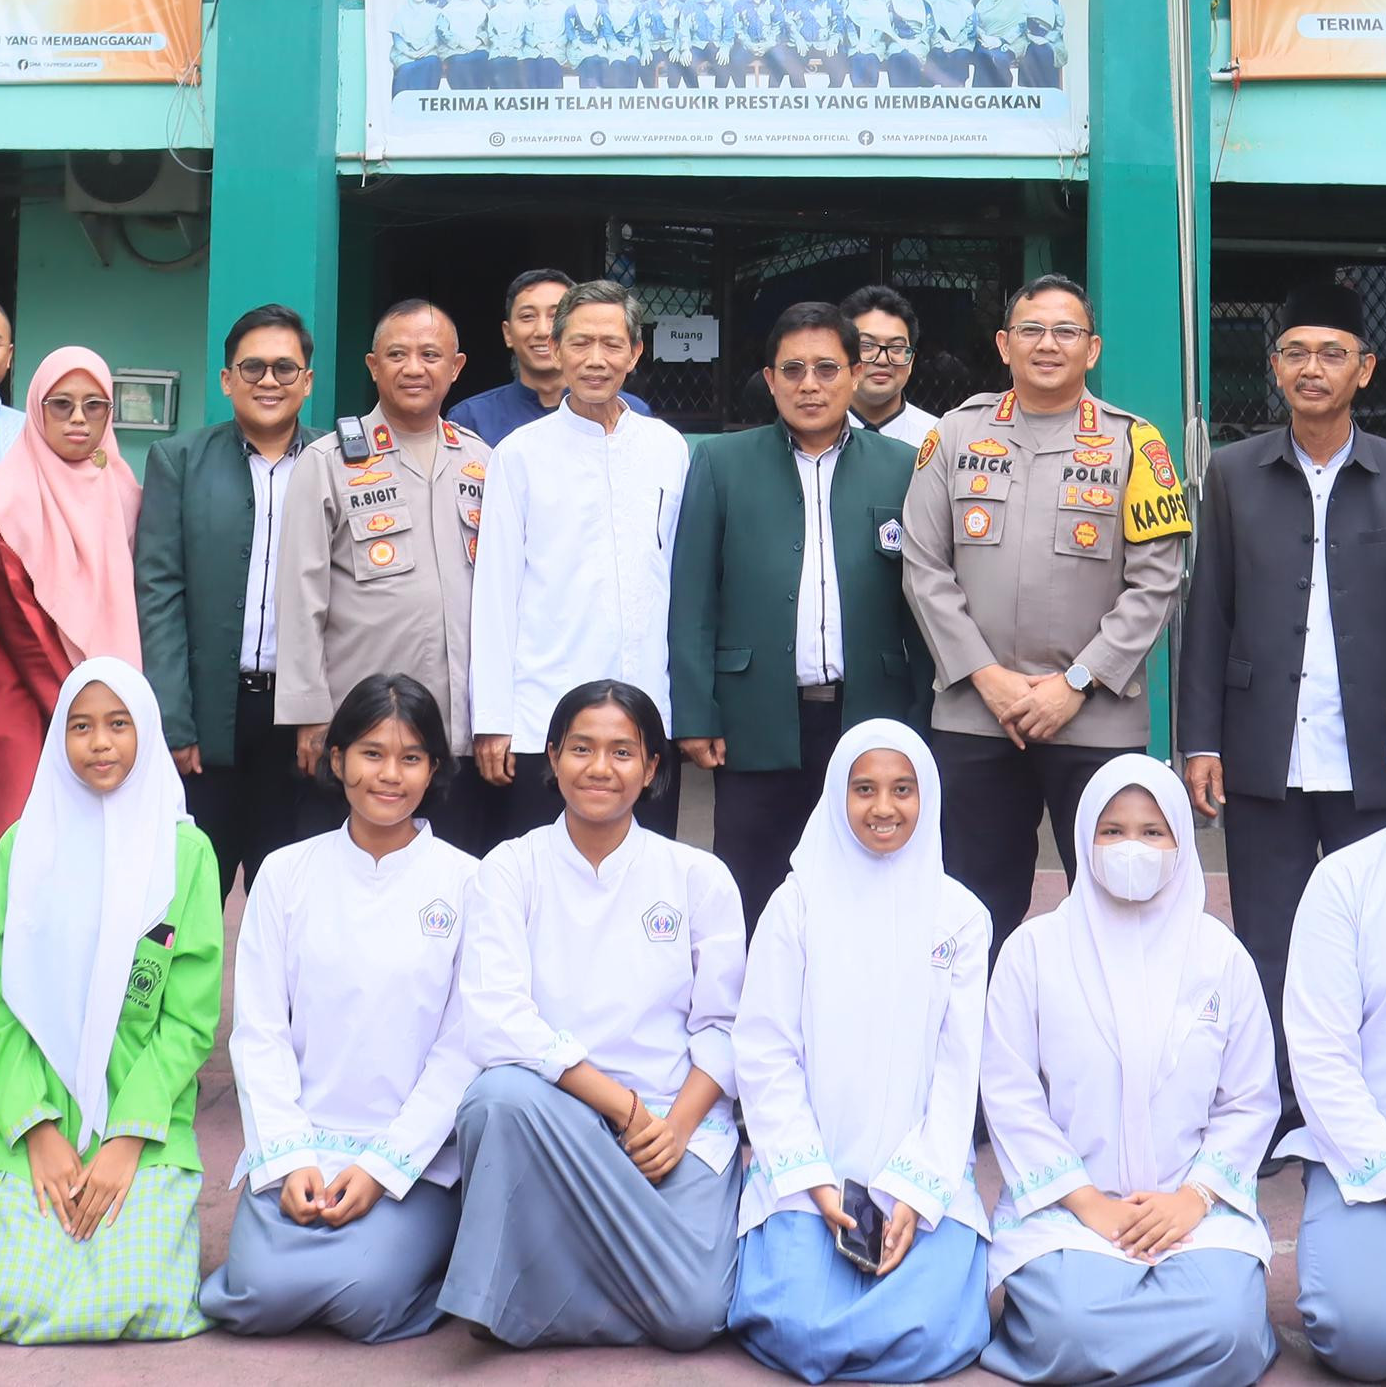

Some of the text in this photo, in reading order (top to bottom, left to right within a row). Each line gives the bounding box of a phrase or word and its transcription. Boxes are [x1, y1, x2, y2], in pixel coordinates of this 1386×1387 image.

[1317, 18, 1383, 31] TERIMA
[6, 35, 38, 45] YANG
[42, 35, 151, 45] MEMBANGGAKAN
[419, 96, 1041, 110] TERIMA KASIH TELAH MENGUKIR PRESTASI YANG MEMBANGGAKAN
[670, 331, 703, 341] Ruang
[683, 343, 690, 352] 3
[958, 455, 1013, 474] ERICK
[1063, 467, 1119, 485] POLRI
[459, 483, 483, 499] POL
[1131, 500, 1159, 532] KA
